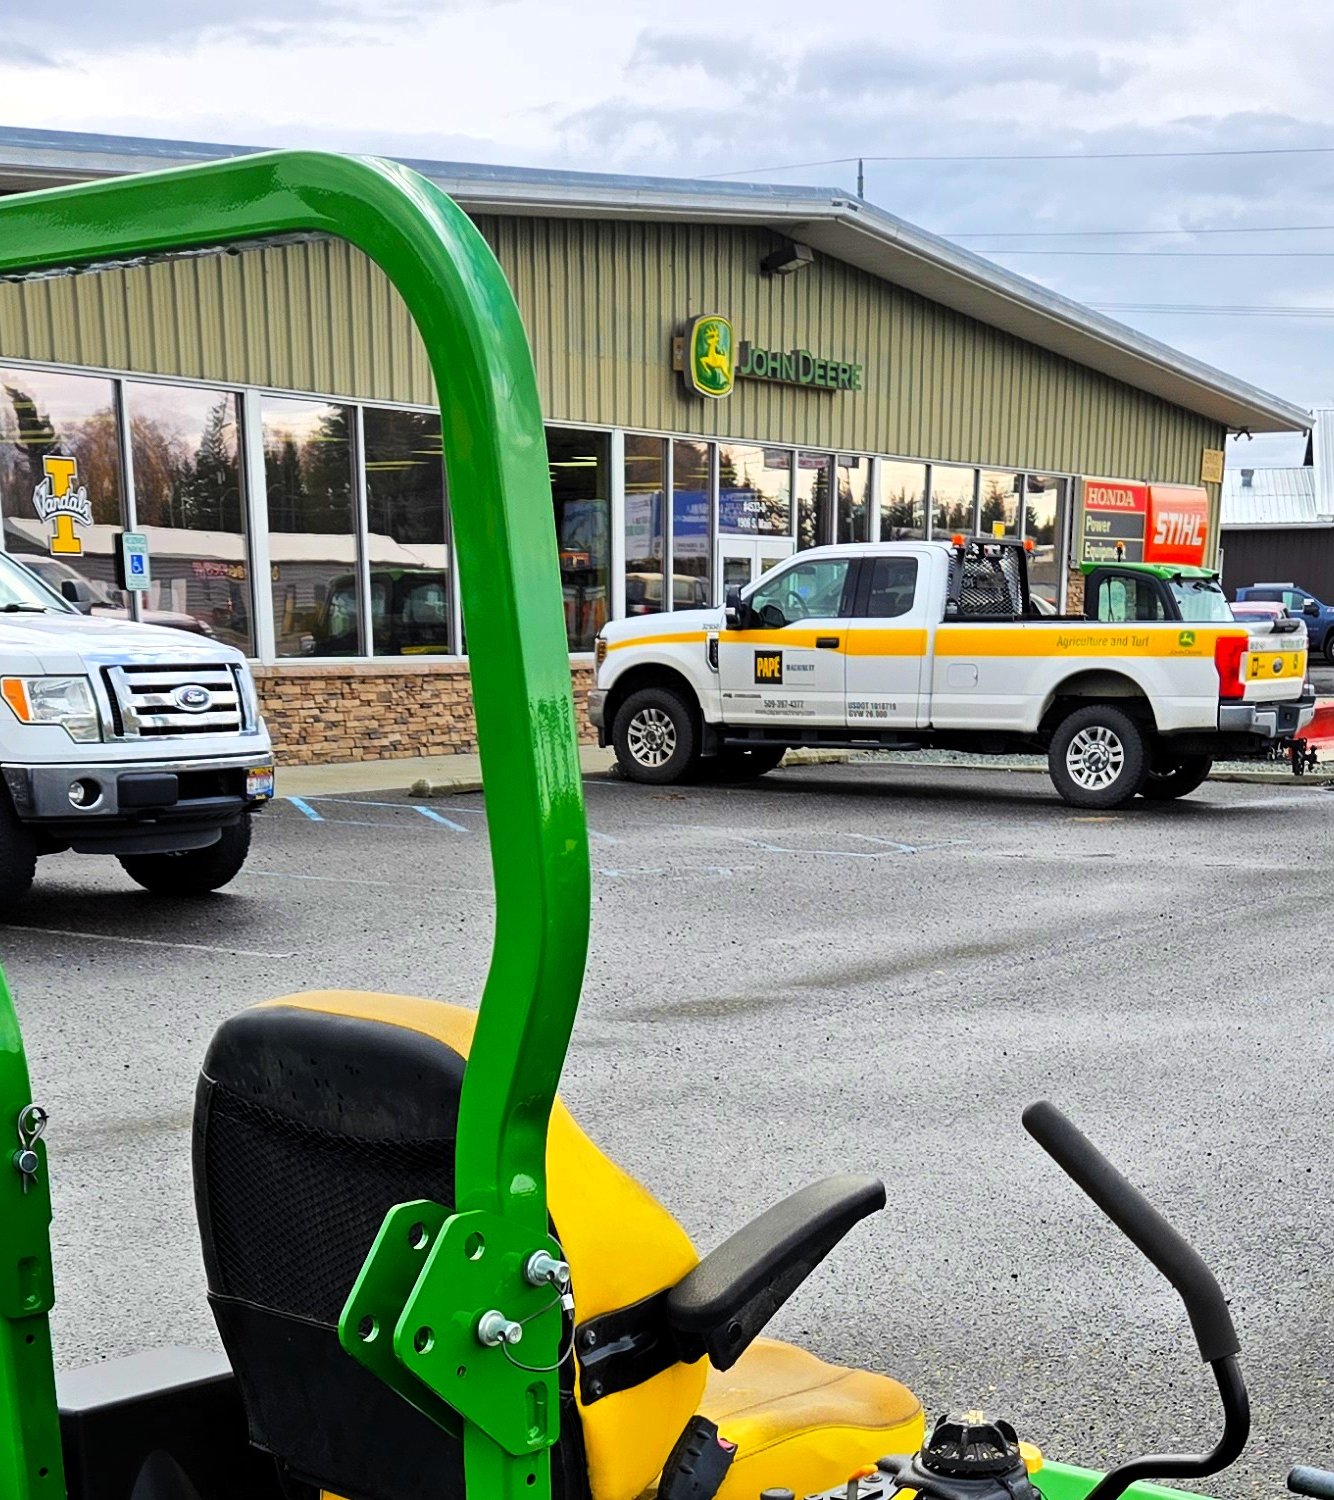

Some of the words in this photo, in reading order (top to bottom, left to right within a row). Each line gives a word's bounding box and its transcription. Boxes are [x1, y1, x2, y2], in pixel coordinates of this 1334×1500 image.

[738, 340, 797, 380] JOHN
[797, 348, 862, 390] DEERE
[33, 477, 94, 528] Vandals
[1087, 487, 1135, 508] HONDA
[1085, 516, 1112, 534] Power
[1153, 512, 1203, 546] STIHL
[1056, 636, 1108, 649] Agriculture
[1110, 635, 1128, 647] and
[1131, 635, 1149, 647] Turf
